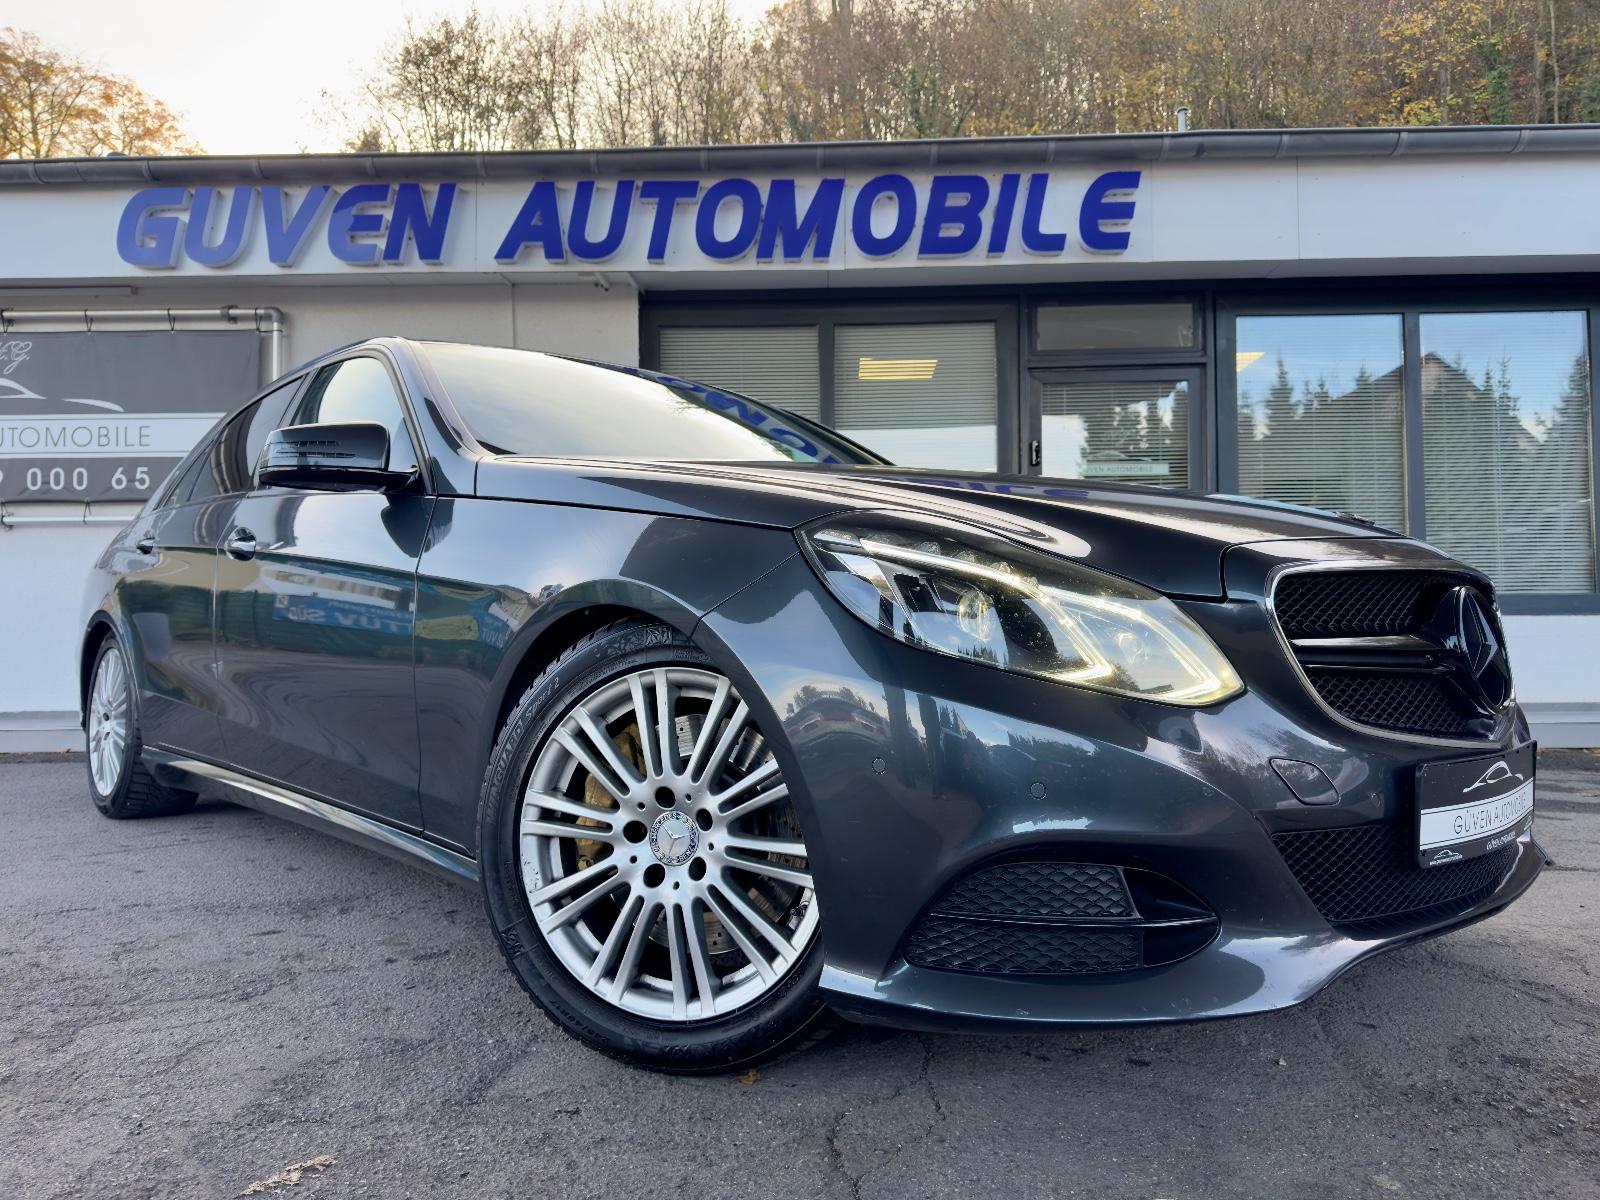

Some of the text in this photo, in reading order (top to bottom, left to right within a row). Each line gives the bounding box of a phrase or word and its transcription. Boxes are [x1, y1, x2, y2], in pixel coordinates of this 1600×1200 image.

[116, 170, 1141, 269] GUVEN AUTOMOBILE
[0, 425, 151, 448] TOMOBILE
[26, 467, 88, 491] 000
[111, 466, 151, 490] 65
